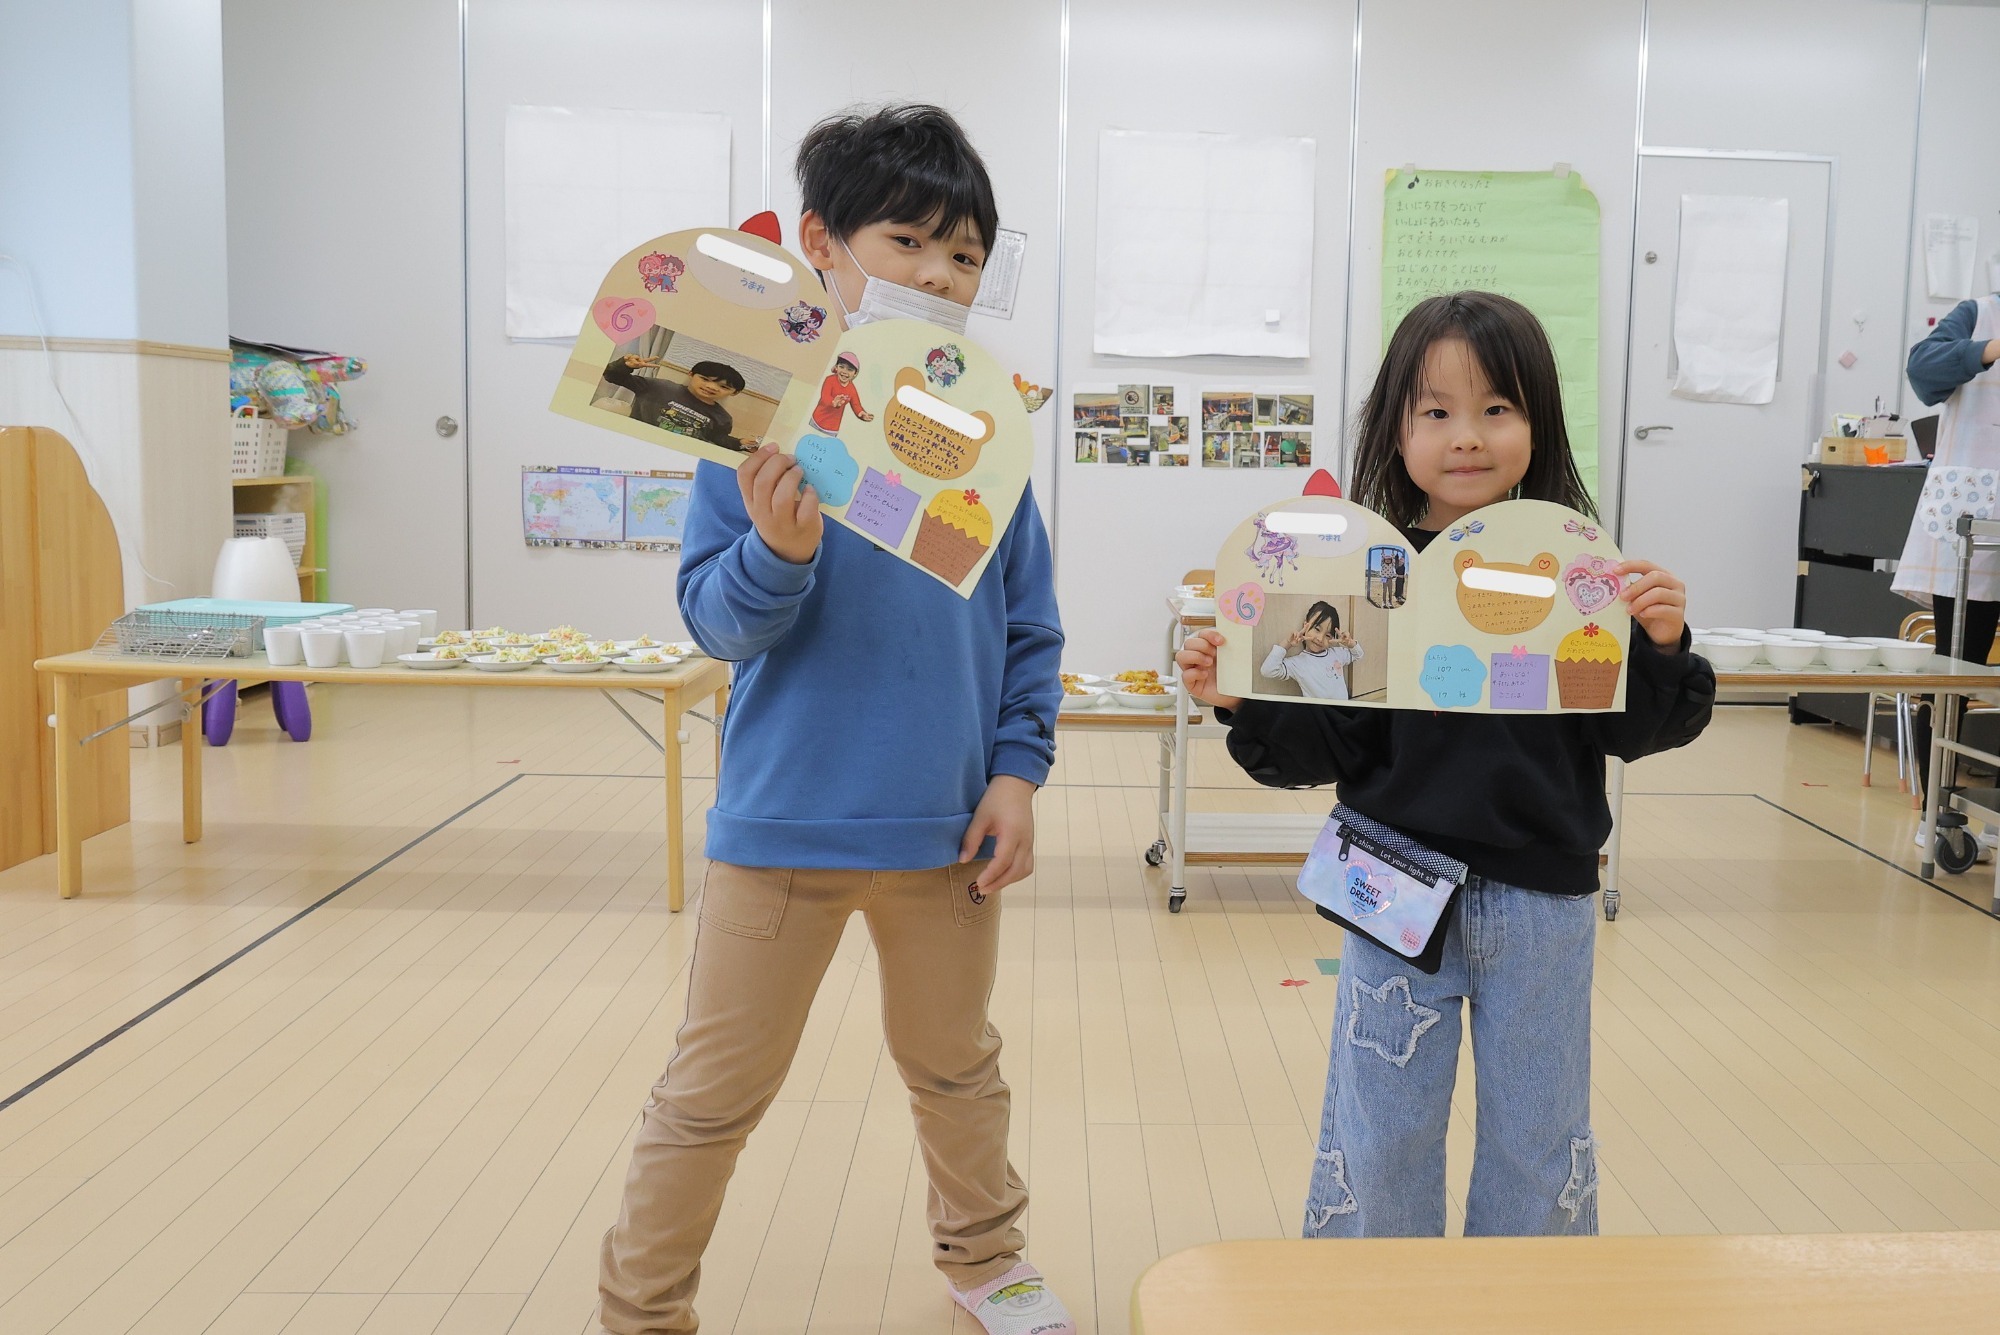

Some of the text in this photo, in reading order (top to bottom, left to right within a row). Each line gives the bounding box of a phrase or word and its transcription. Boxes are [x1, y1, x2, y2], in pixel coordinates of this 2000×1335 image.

[611, 302, 635, 333] 6
[1236, 592, 1256, 621] 6
[1358, 839, 1375, 852] shine
[1380, 849, 1391, 861] Let
[1391, 857, 1408, 870] your
[1408, 864, 1425, 880] light
[1350, 886, 1377, 908] DREAM
[1353, 877, 1382, 898] SWEET
